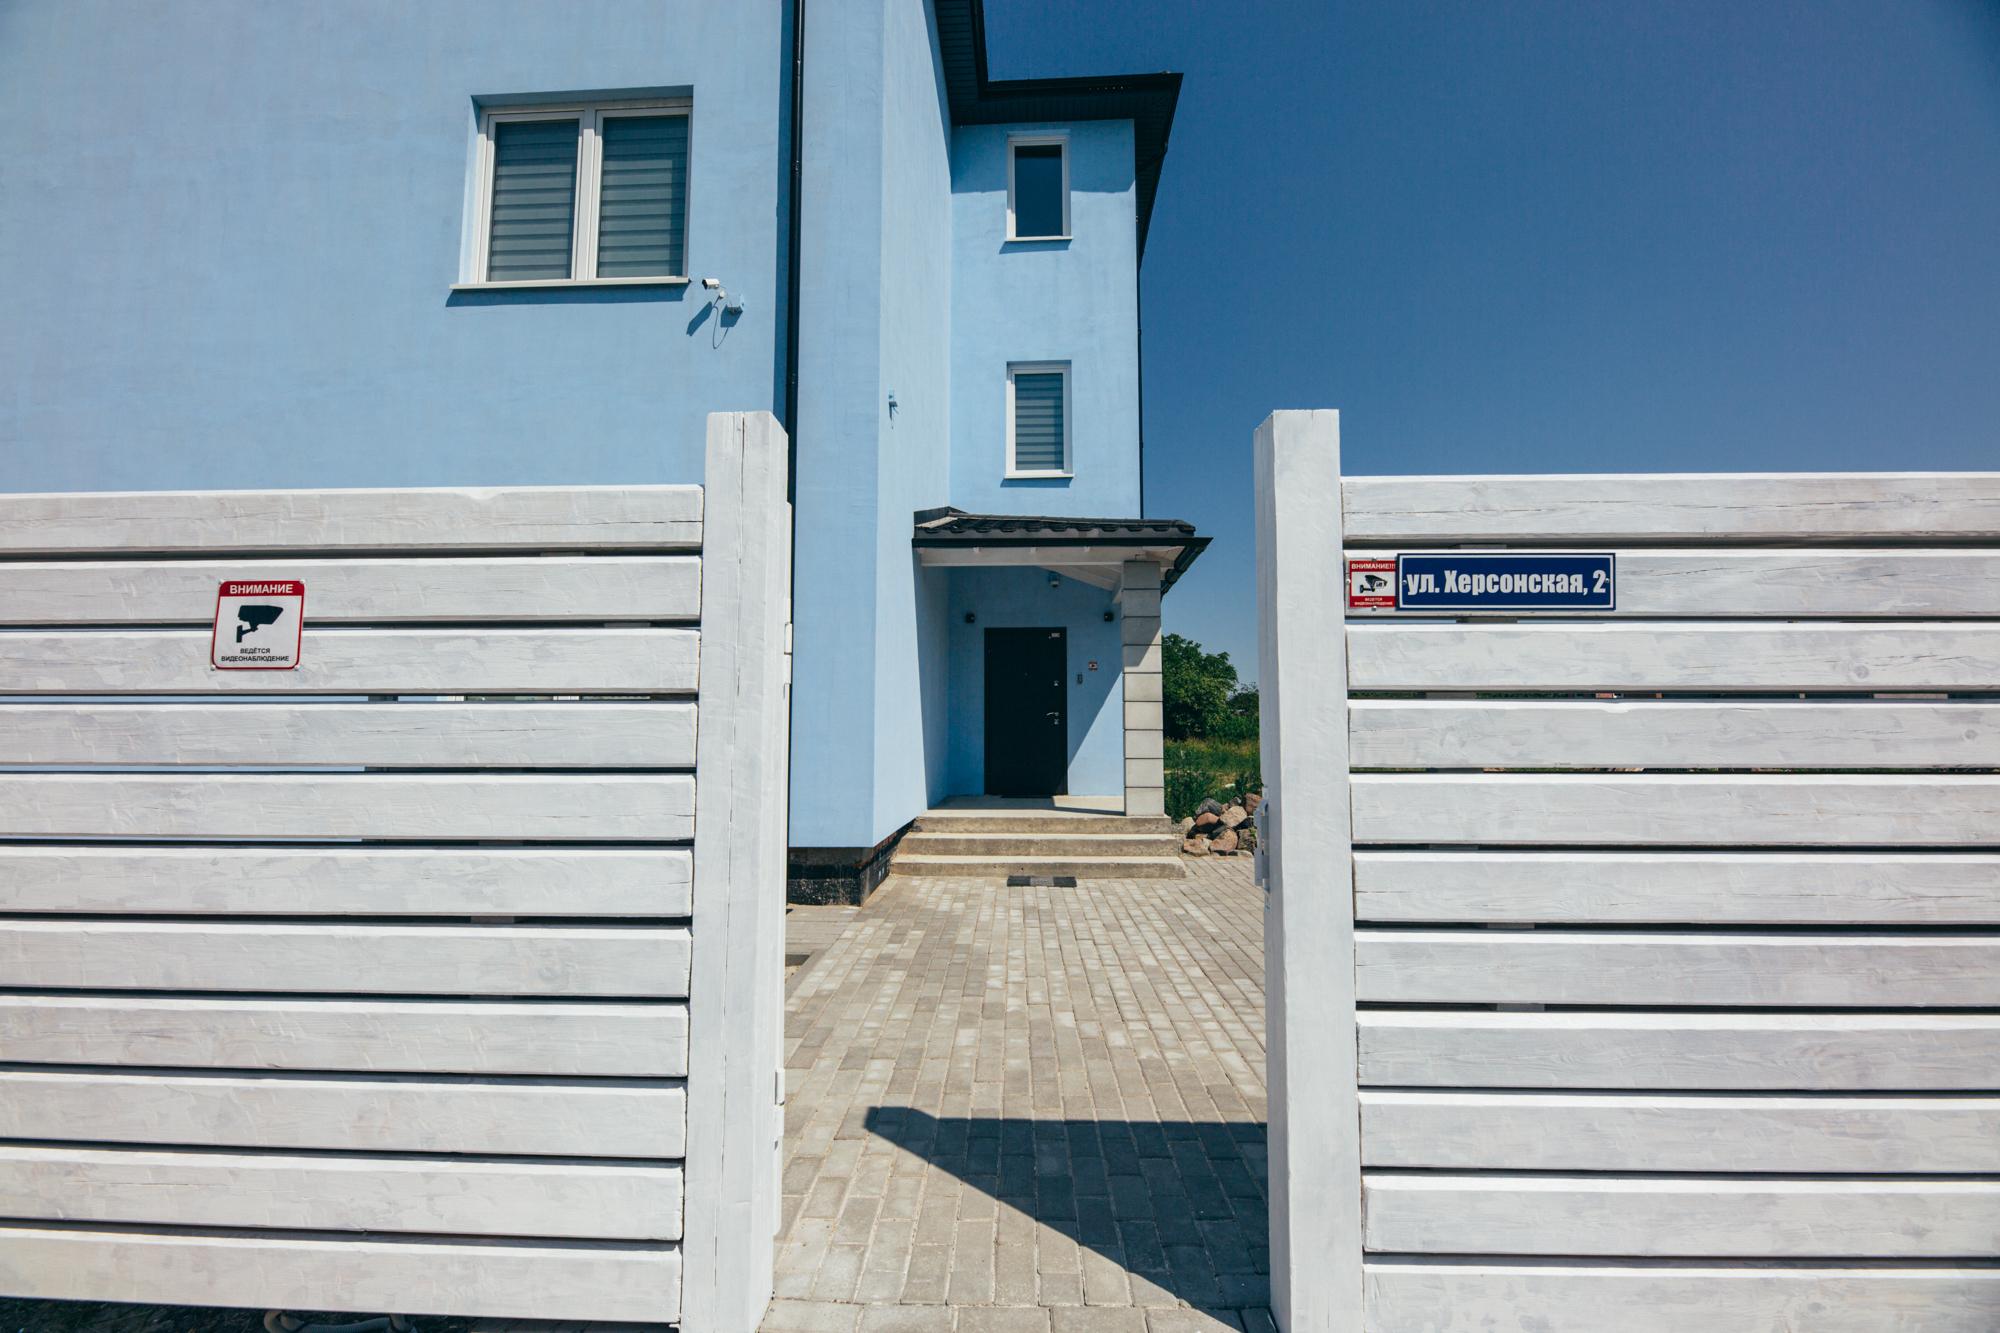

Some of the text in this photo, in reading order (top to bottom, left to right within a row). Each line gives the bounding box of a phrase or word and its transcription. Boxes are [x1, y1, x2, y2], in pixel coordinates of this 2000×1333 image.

[1406, 569, 1606, 596] ул. Херсонская, 2
[229, 584, 294, 594] ВНИМАНИЕ
[220, 655, 290, 663] ВИДЕОНАБЛЮДЕНИЕ
